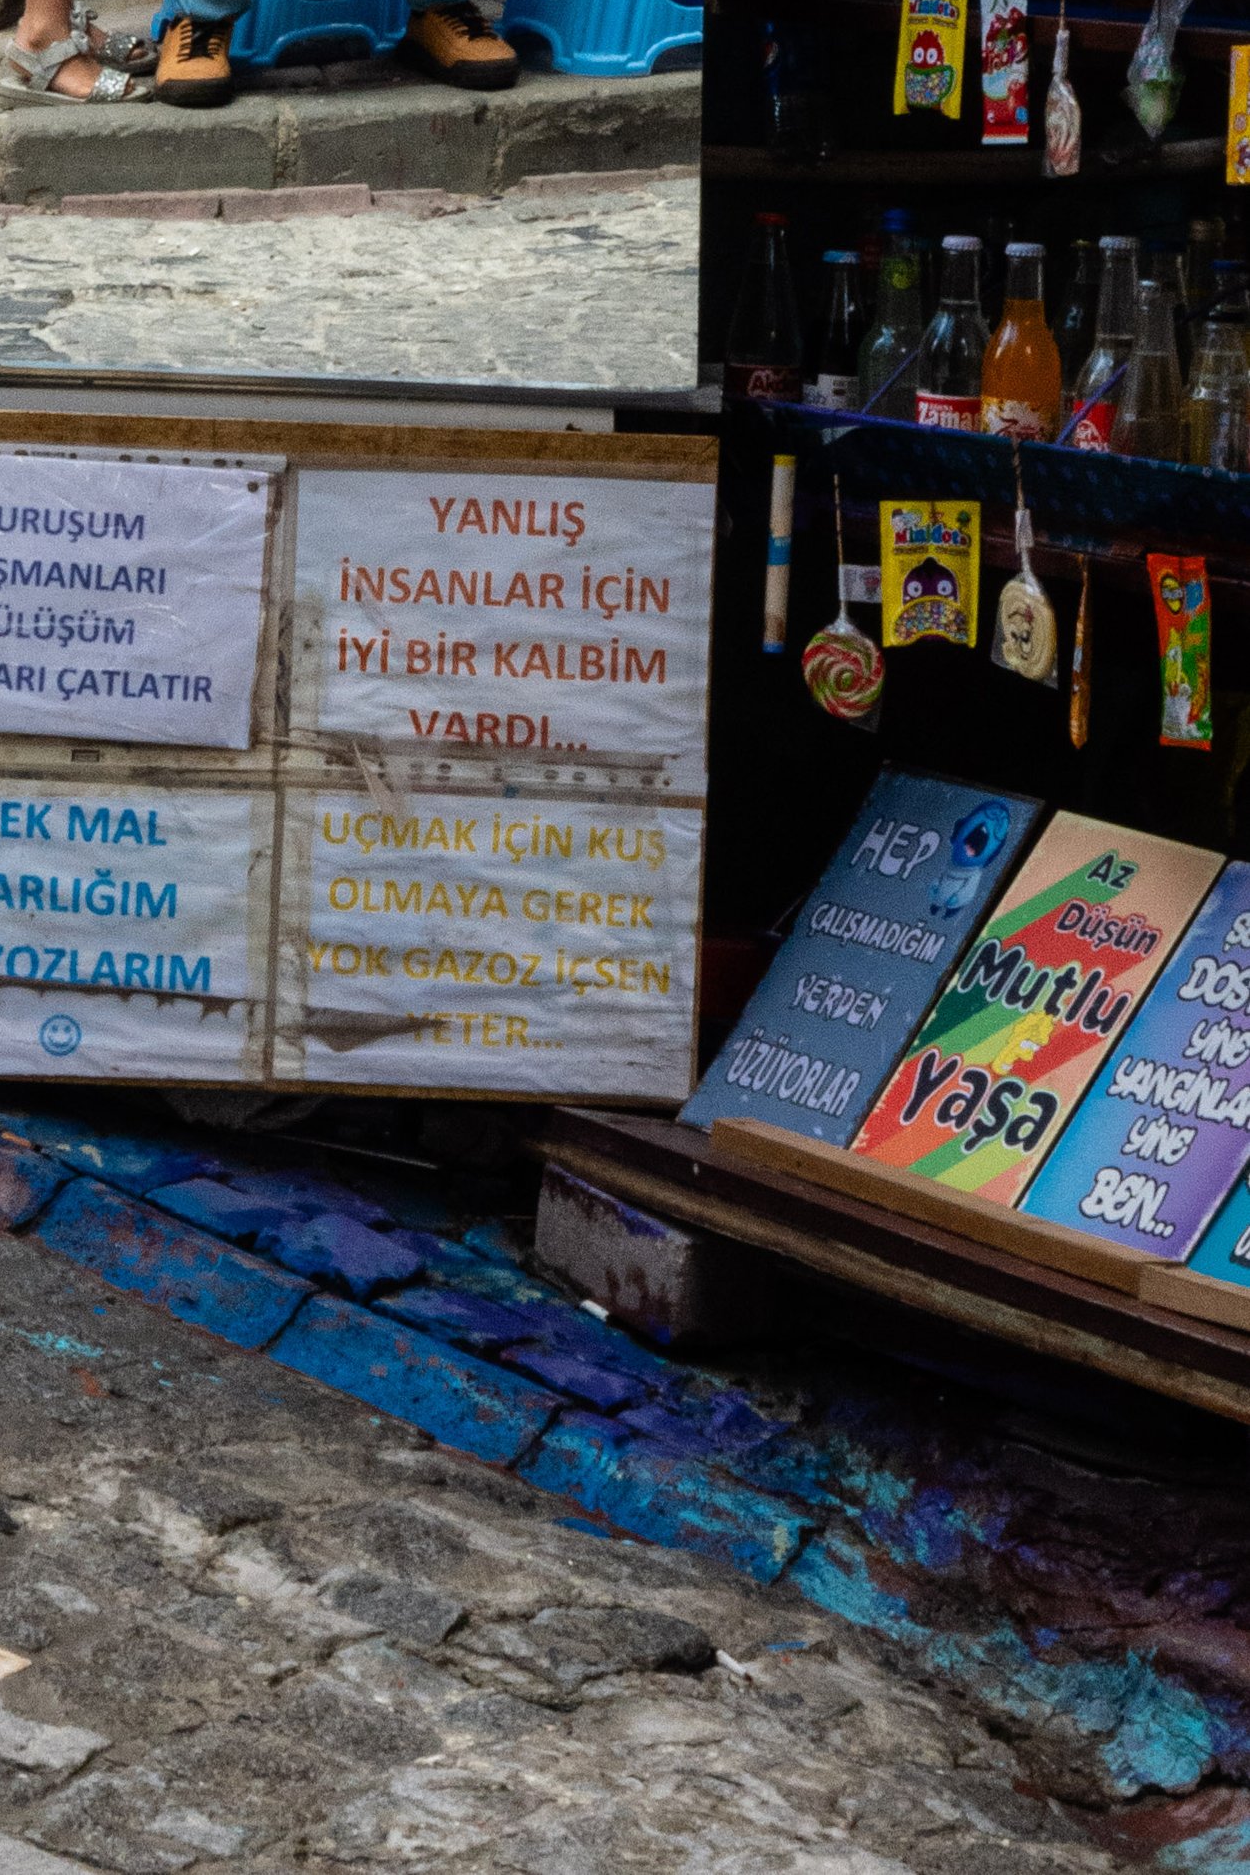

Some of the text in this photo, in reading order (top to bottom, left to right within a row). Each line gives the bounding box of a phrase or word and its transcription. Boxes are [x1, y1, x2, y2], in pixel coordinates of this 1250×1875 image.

[430, 496, 587, 546] YANLIŞ
[340, 557, 670, 620] İNSANLAR İÇİN
[338, 628, 667, 684] İYİ BİR KALBİM
[56, 668, 213, 703] ÇATLATIR
[409, 709, 588, 753] VARDI...
[68, 804, 167, 846] MAL
[322, 813, 667, 871] UÇMAK İÇİN KUŞ
[851, 817, 940, 880] HEP
[328, 877, 654, 928] OLMAYA GEREK
[1055, 898, 1161, 955] Düşün
[810, 903, 946, 964] ÇALIŞMADIĞIM
[306, 940, 670, 996] YOK GAZOZ İÇSEN
[957, 939, 1133, 1035] Mutlu
[794, 973, 888, 1031] YERDEN
[726, 1028, 861, 1117] ÜZÜYORLAR
[900, 1050, 1060, 1154] Yaşa
